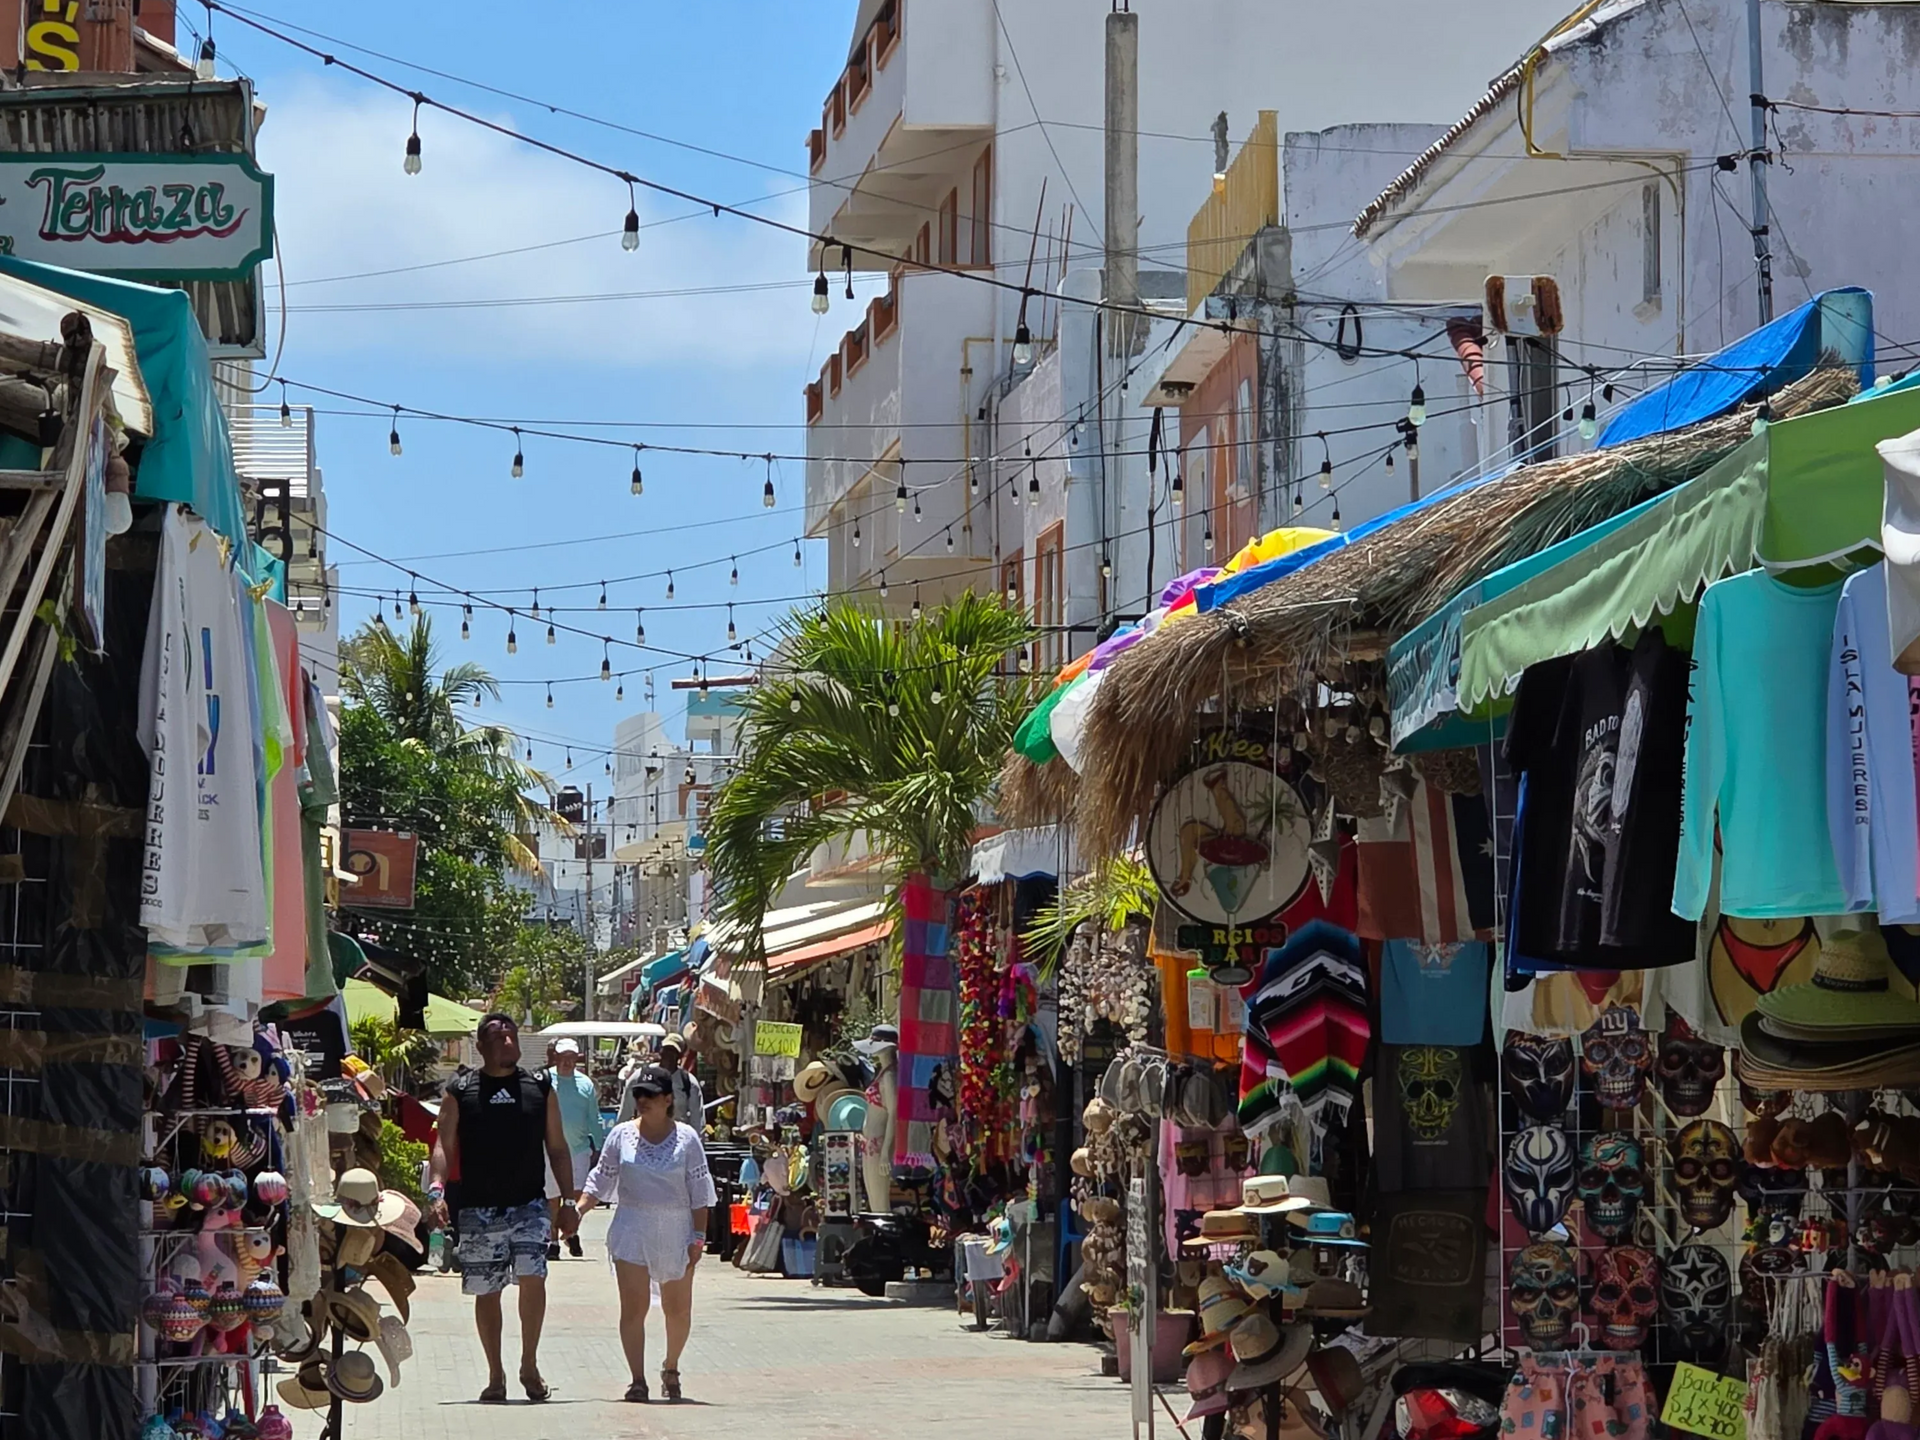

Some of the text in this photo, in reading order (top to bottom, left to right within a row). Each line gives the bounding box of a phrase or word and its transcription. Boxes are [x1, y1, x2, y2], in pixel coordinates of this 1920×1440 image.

[25, 164, 249, 243] Terraza
[1585, 718, 1605, 751] BAD
[1208, 946, 1254, 962] BAR
[1397, 1265, 1460, 1279] MEXICO
[1678, 1407, 1694, 1428] 2
[1709, 1416, 1737, 1437] 700
[1714, 1397, 1740, 1421] 400
